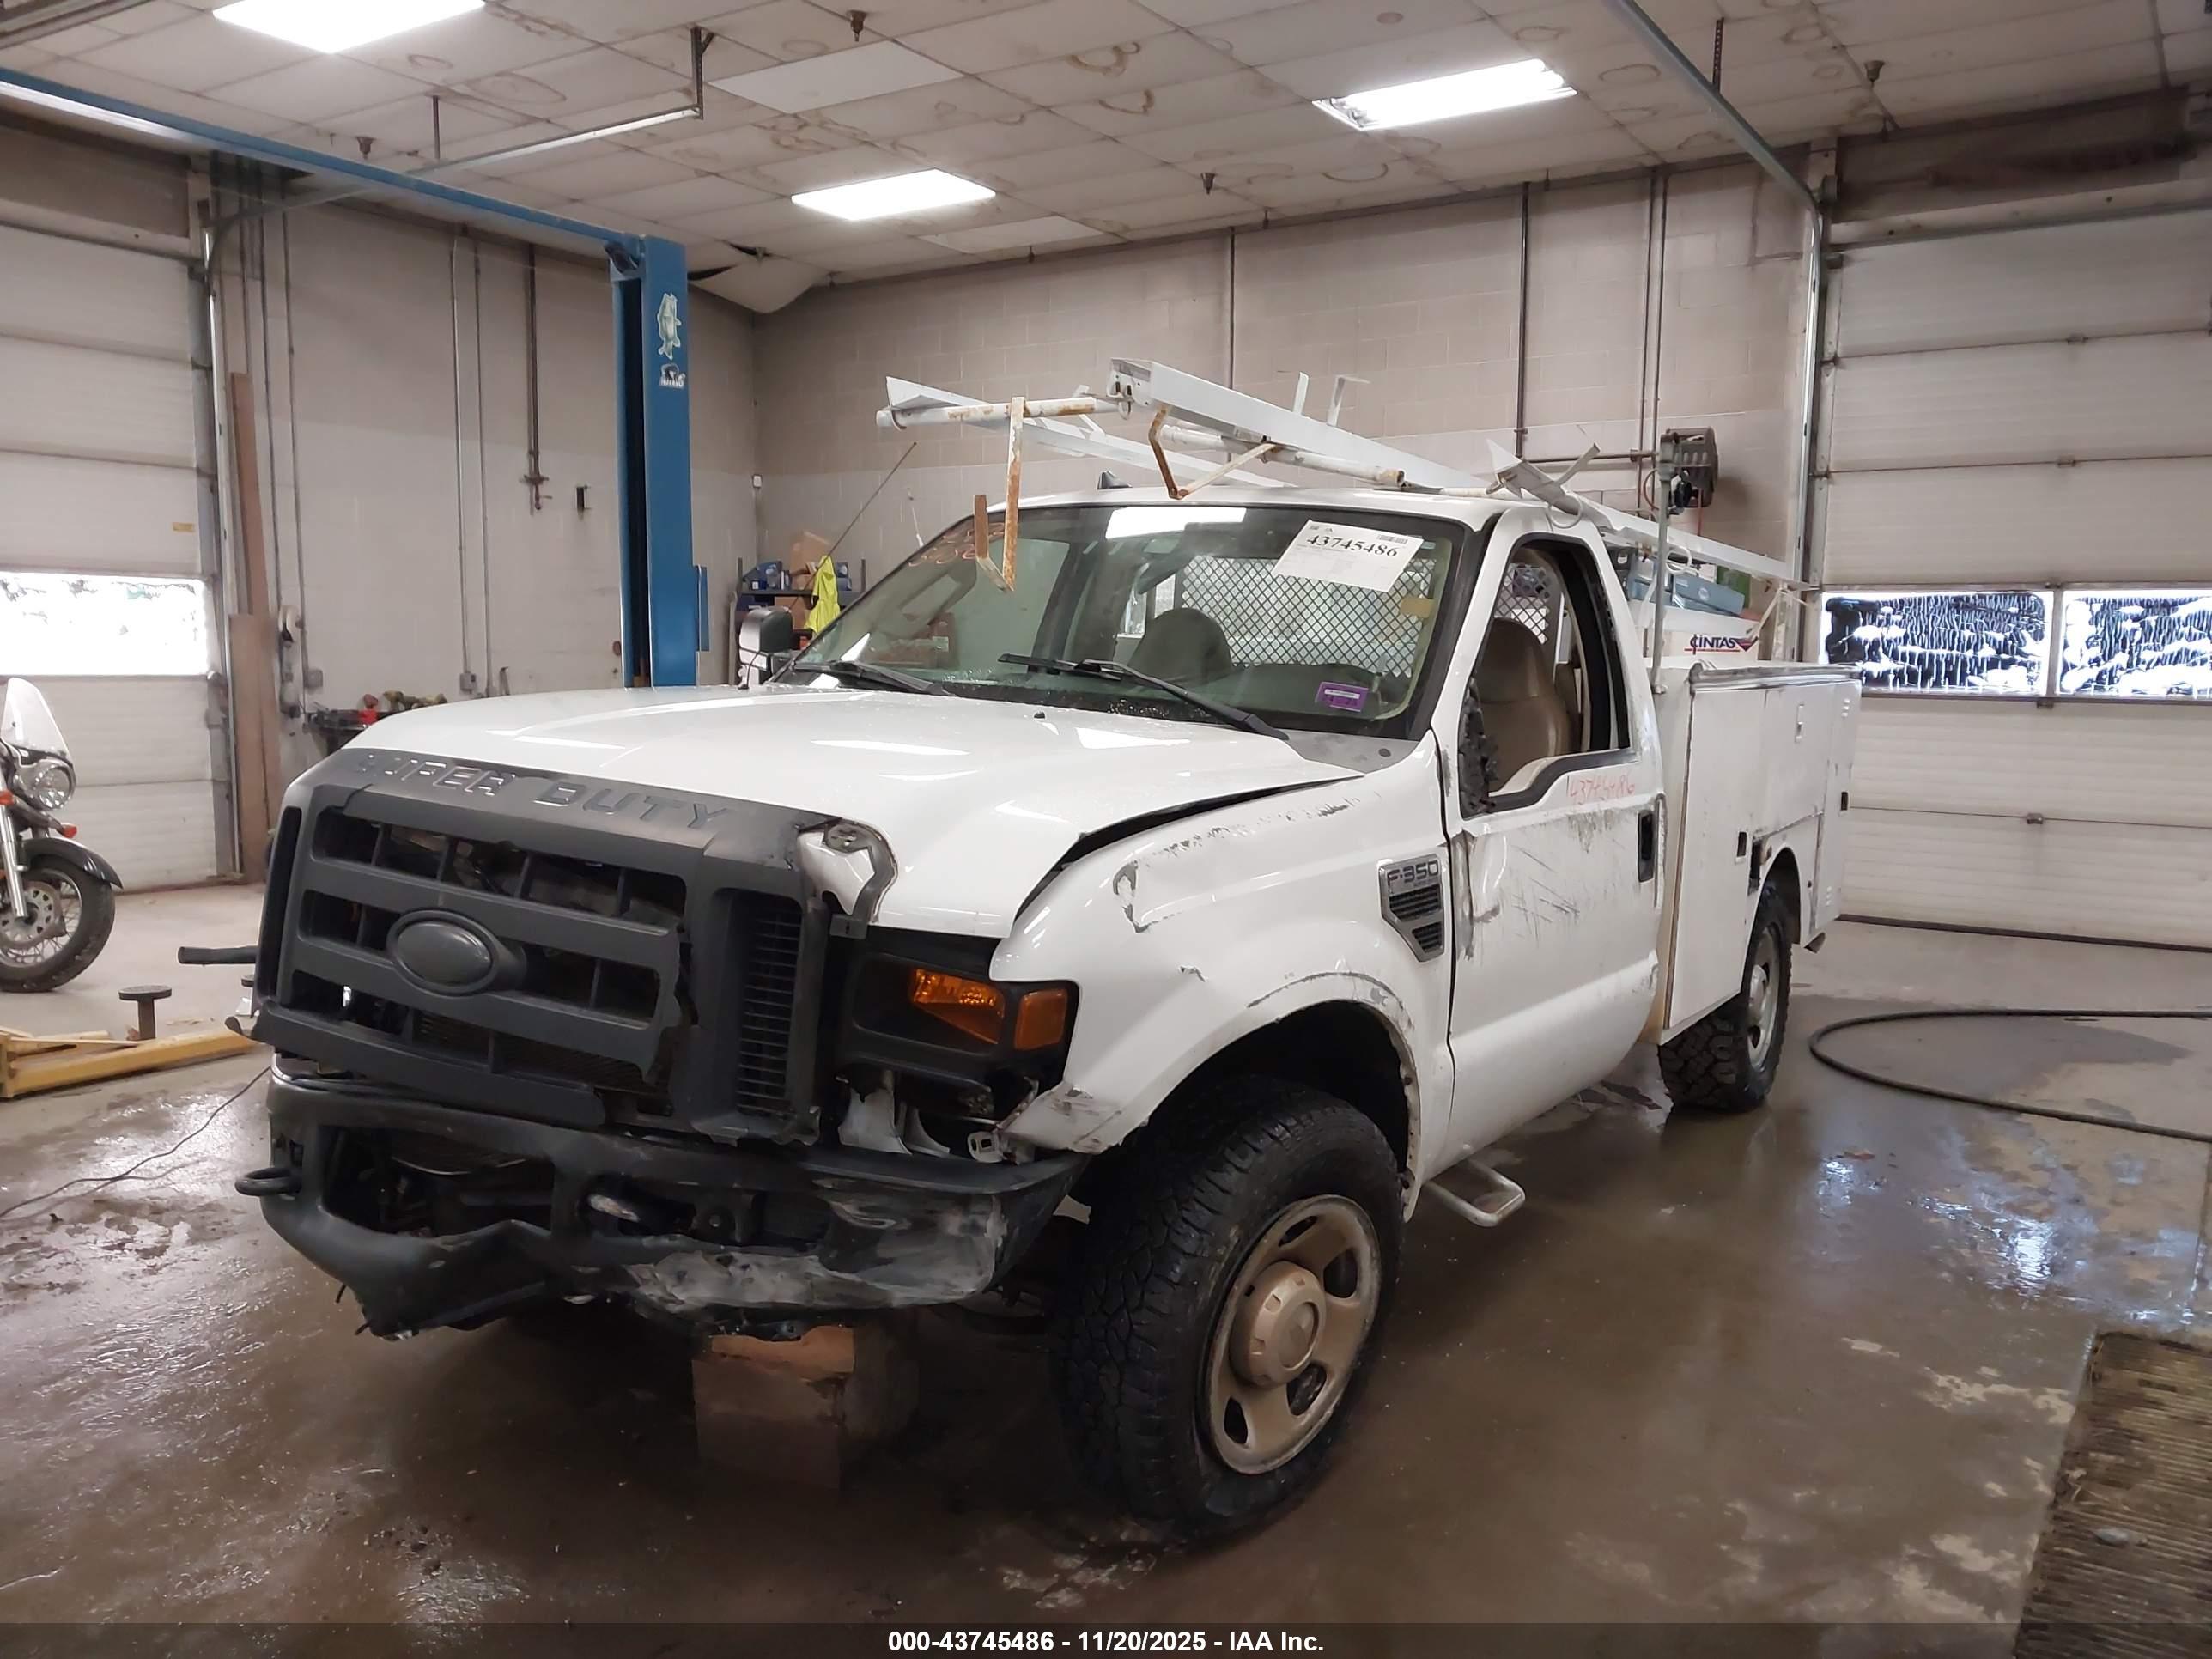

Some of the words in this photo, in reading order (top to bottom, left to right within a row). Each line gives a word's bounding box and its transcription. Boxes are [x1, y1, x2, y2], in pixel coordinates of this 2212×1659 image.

[1307, 534, 1399, 557] 43745486
[1689, 633, 1736, 655] CINTAS
[533, 781, 729, 829] DUTY
[1387, 860, 1439, 886] F-350
